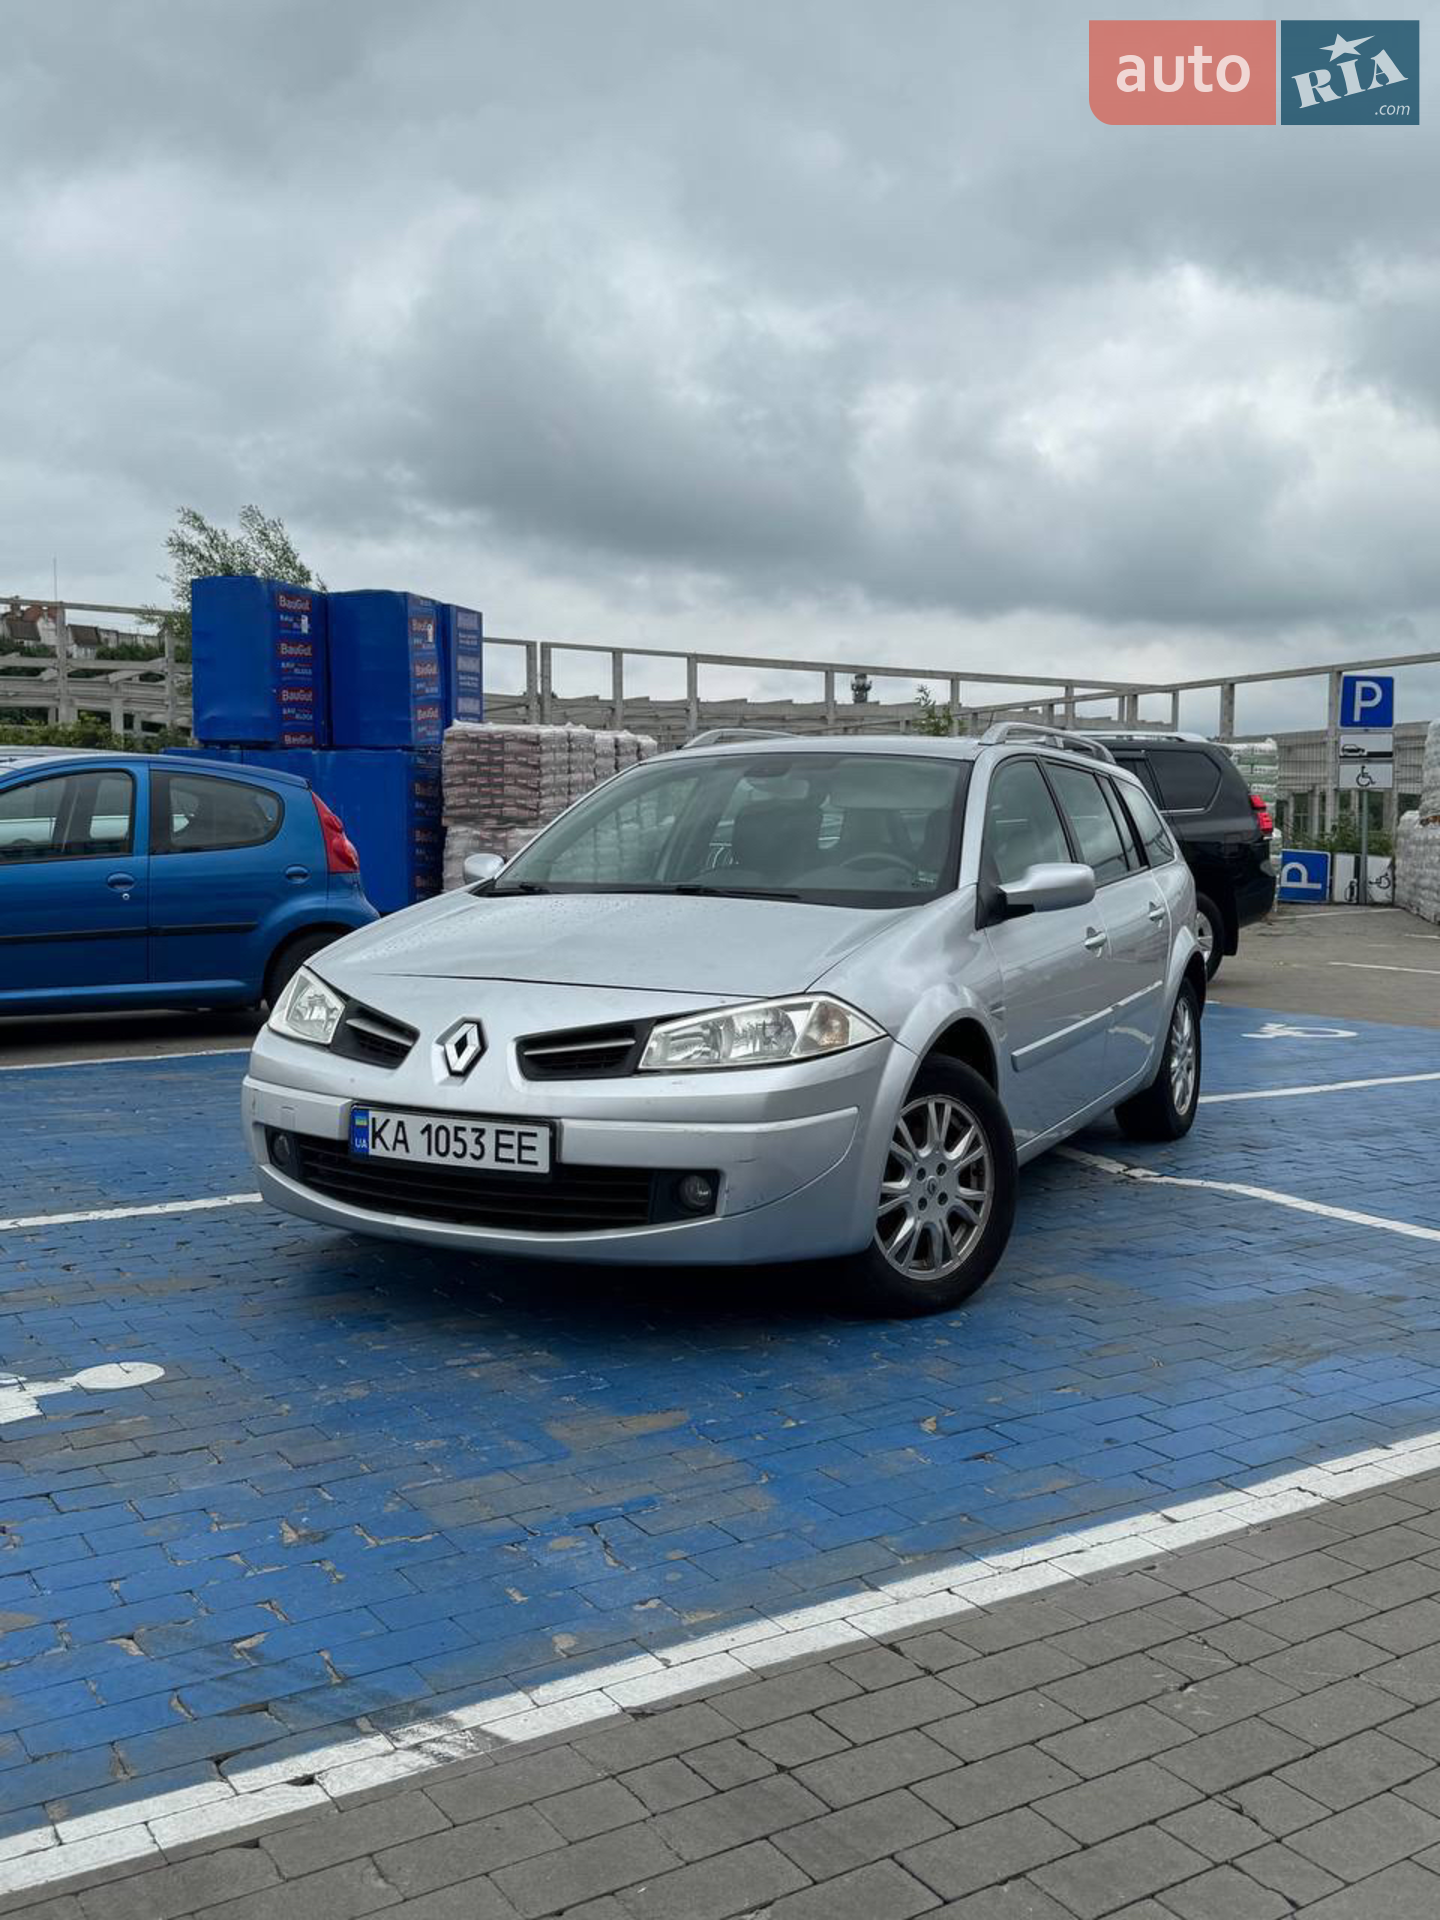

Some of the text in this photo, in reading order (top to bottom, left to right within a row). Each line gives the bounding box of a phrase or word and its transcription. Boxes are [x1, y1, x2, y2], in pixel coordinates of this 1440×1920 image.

[1353, 681, 1382, 722] P
[355, 1138, 367, 1149] UA
[371, 1117, 538, 1166] KA 1053 EE
